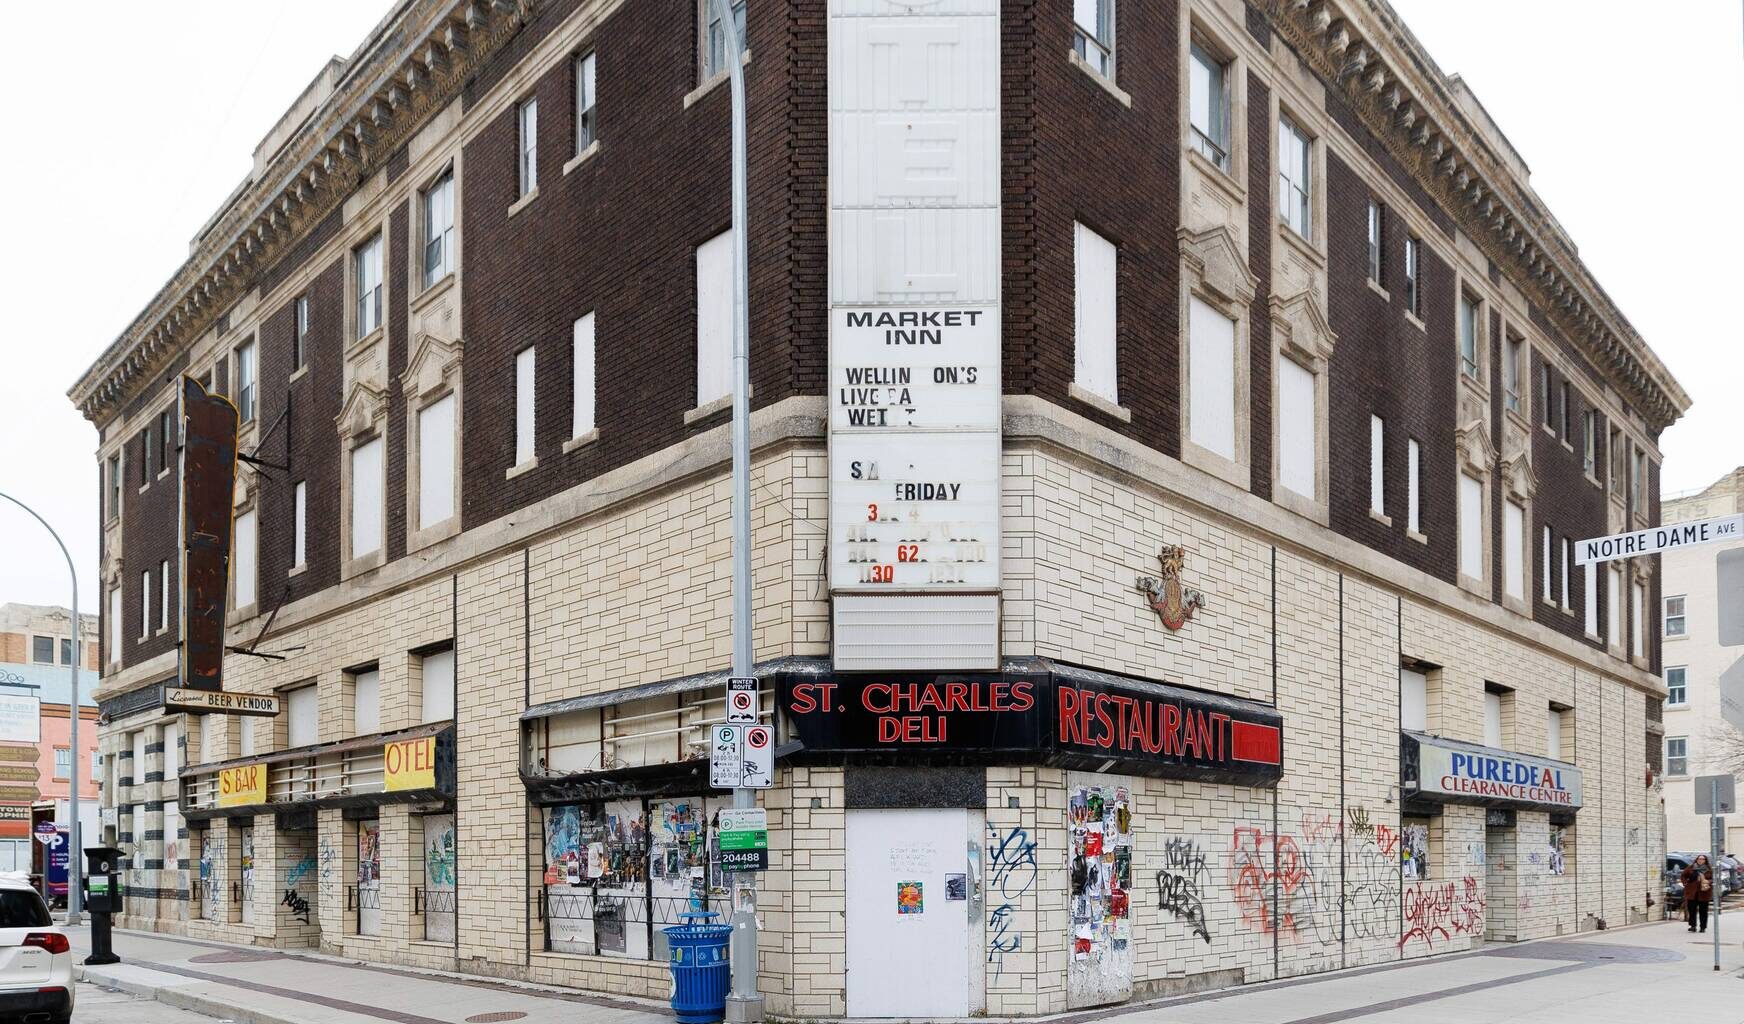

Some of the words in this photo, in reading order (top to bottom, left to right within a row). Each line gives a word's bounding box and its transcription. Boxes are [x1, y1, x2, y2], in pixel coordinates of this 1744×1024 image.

[847, 310, 982, 327] MARKET
[886, 329, 942, 345] INN
[846, 367, 911, 384] WELLIN
[933, 366, 978, 384] ON'S
[896, 483, 961, 501] FRIDAY
[867, 503, 878, 522] 3
[1587, 534, 1646, 559] NOTRE
[1657, 523, 1709, 548] DAME
[1717, 522, 1736, 535] AVE
[897, 544, 919, 562] 62
[208, 694, 232, 707] BEER
[236, 696, 273, 710] VENDOR
[790, 683, 846, 713] ST.
[861, 681, 1035, 713] CHARLES
[878, 716, 947, 743] DELI
[1058, 686, 1231, 762] RESTAURANT
[386, 739, 434, 775] OTEL
[235, 766, 258, 791] BAR
[1451, 752, 1566, 790] PUREDEAL
[1441, 776, 1526, 799] CLEARANCE
[1529, 787, 1572, 804] CENTRE
[722, 852, 760, 863] 204488
